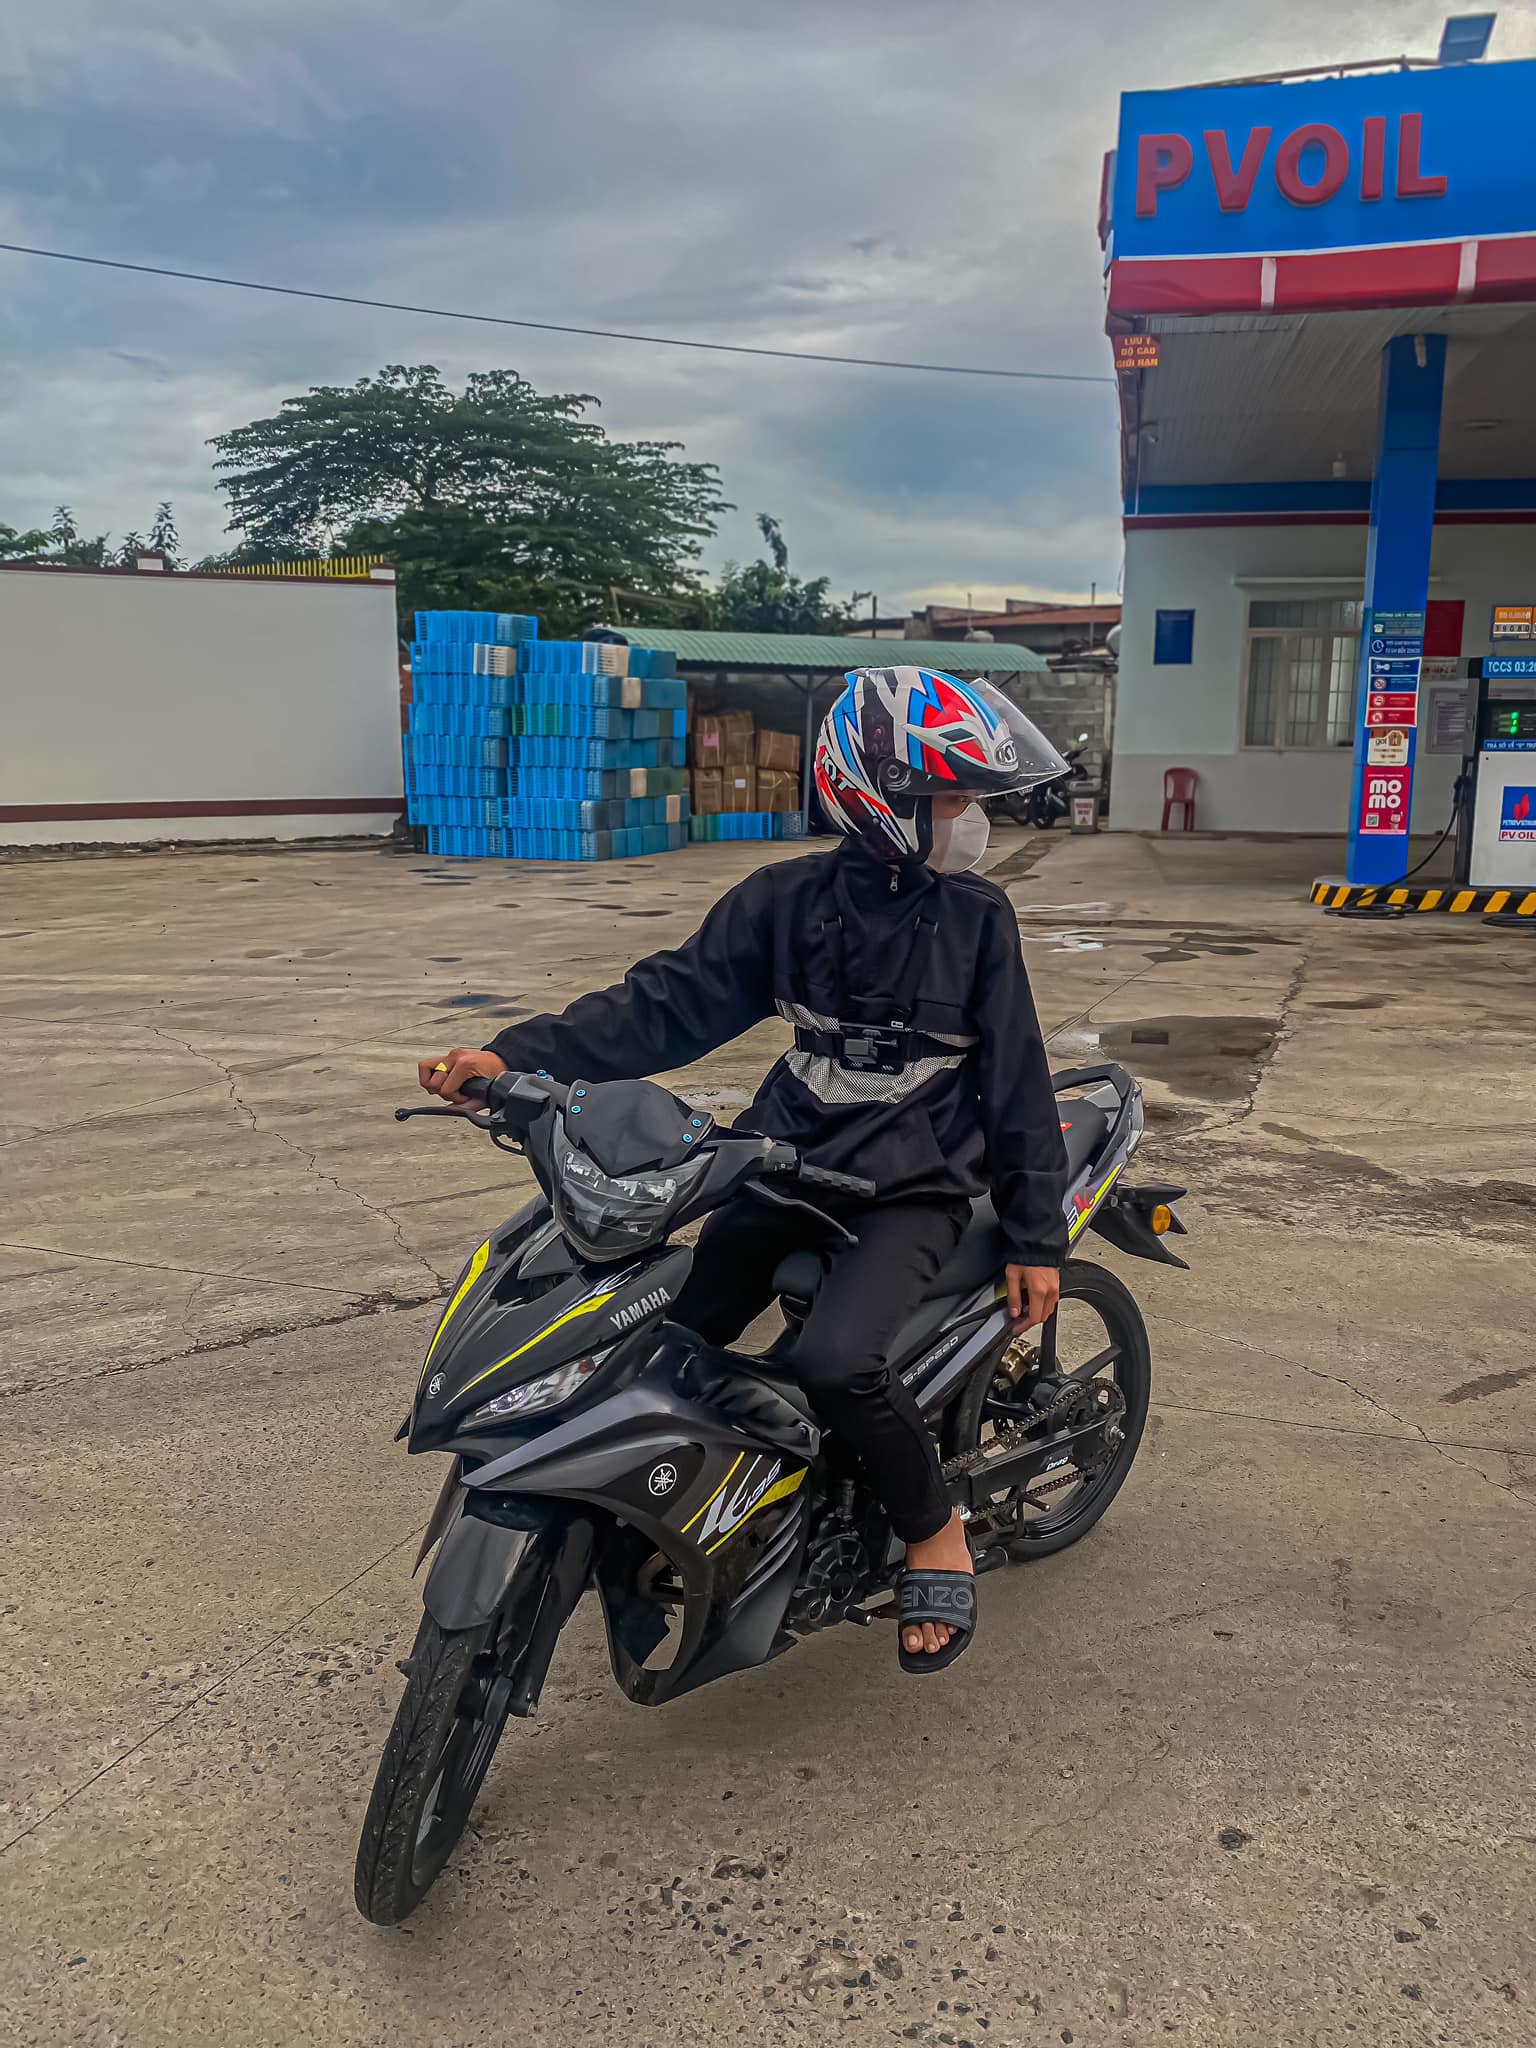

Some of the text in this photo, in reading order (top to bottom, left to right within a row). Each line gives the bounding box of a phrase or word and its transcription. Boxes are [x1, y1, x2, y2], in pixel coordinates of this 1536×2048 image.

[1136, 112, 1448, 217] PVOIL
[1488, 661, 1512, 673] TCCS
[609, 1287, 671, 1330] YAMAHA
